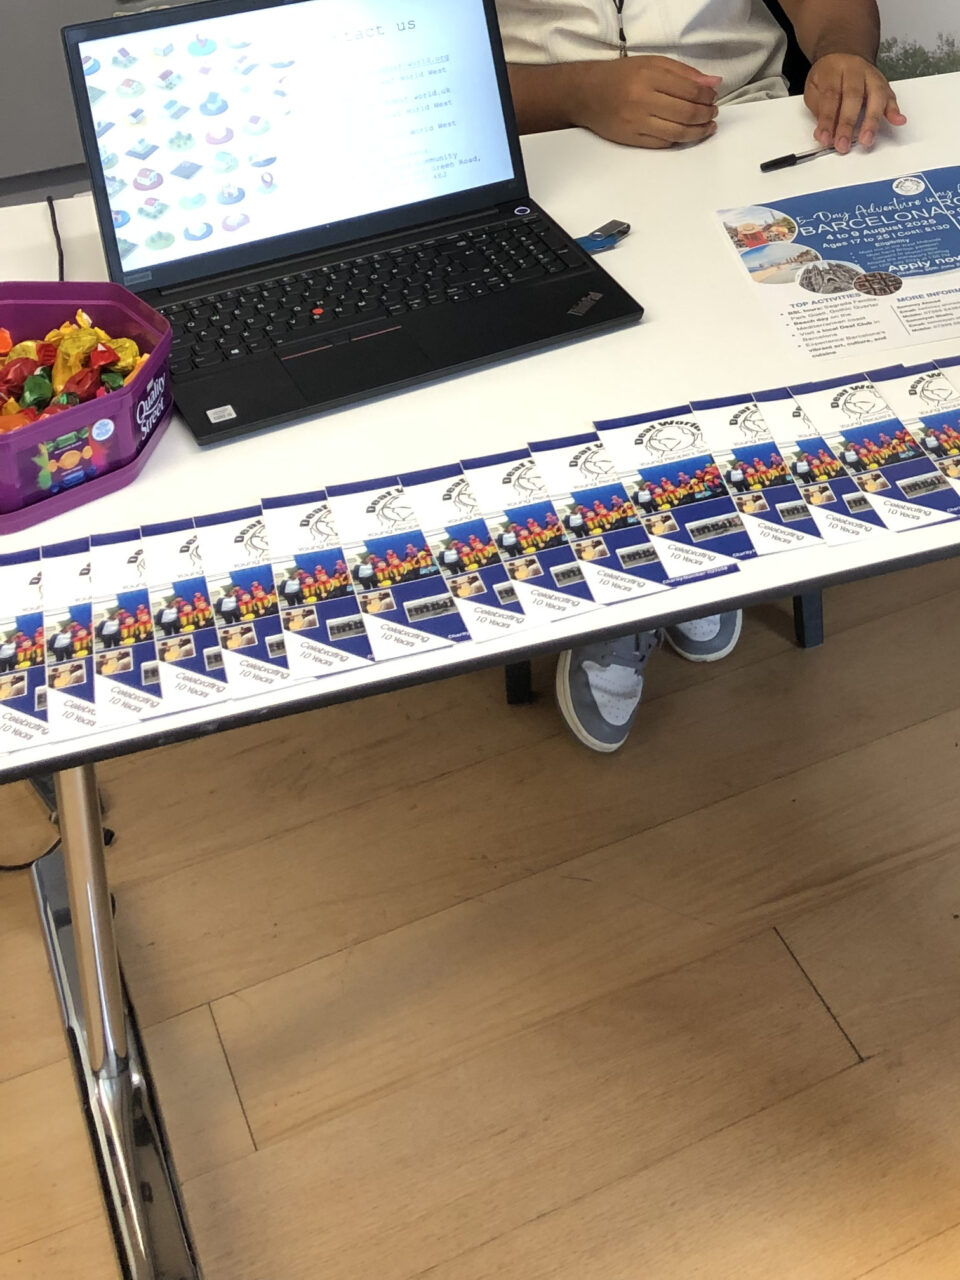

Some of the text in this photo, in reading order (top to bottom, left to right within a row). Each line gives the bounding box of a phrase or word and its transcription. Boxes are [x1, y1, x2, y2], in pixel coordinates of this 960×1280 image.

[397, 20, 416, 31] us
[800, 207, 948, 237] BARCELONA
[863, 225, 903, 237] August
[888, 259, 931, 273] Apply
[137, 373, 165, 424] Quality
[141, 397, 164, 440] Street
